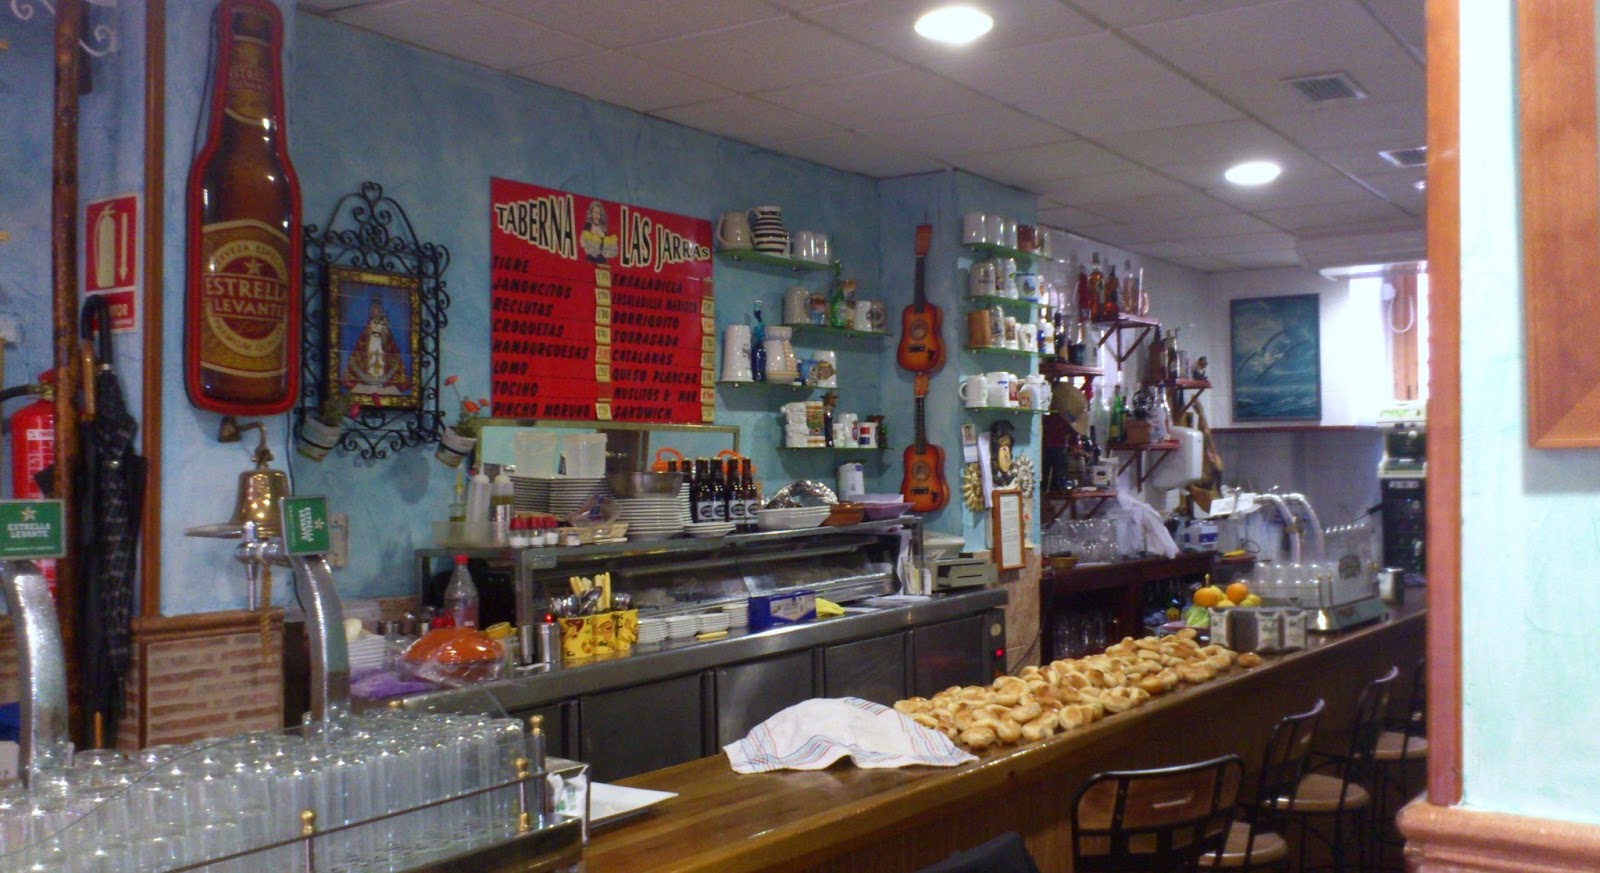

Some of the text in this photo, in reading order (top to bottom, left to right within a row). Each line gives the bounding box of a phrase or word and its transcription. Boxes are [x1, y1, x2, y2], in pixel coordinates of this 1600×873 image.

[495, 195, 711, 272] TABERNA LAS JARRAS
[493, 255, 529, 273] TIGRE
[492, 278, 572, 299] JAMONCITOS
[612, 273, 683, 294] ENSALADILLA
[214, 297, 285, 317] LEVANTE
[493, 297, 553, 318] RECLUTAS
[493, 318, 564, 338] CROQUETAS
[612, 311, 679, 330] BORRIQUITO
[493, 339, 590, 360] HAMBURGUESAS
[612, 349, 673, 366] CATALANAS
[493, 360, 528, 375] LOMO
[612, 367, 647, 382] QUESO
[653, 370, 697, 385] PLANCHA
[493, 380, 538, 397] TOCINO
[493, 401, 538, 417] PINCHO
[543, 403, 590, 418] MORUNO
[612, 405, 673, 420] SANDWICH
[8, 523, 51, 531] ESTRELLA
